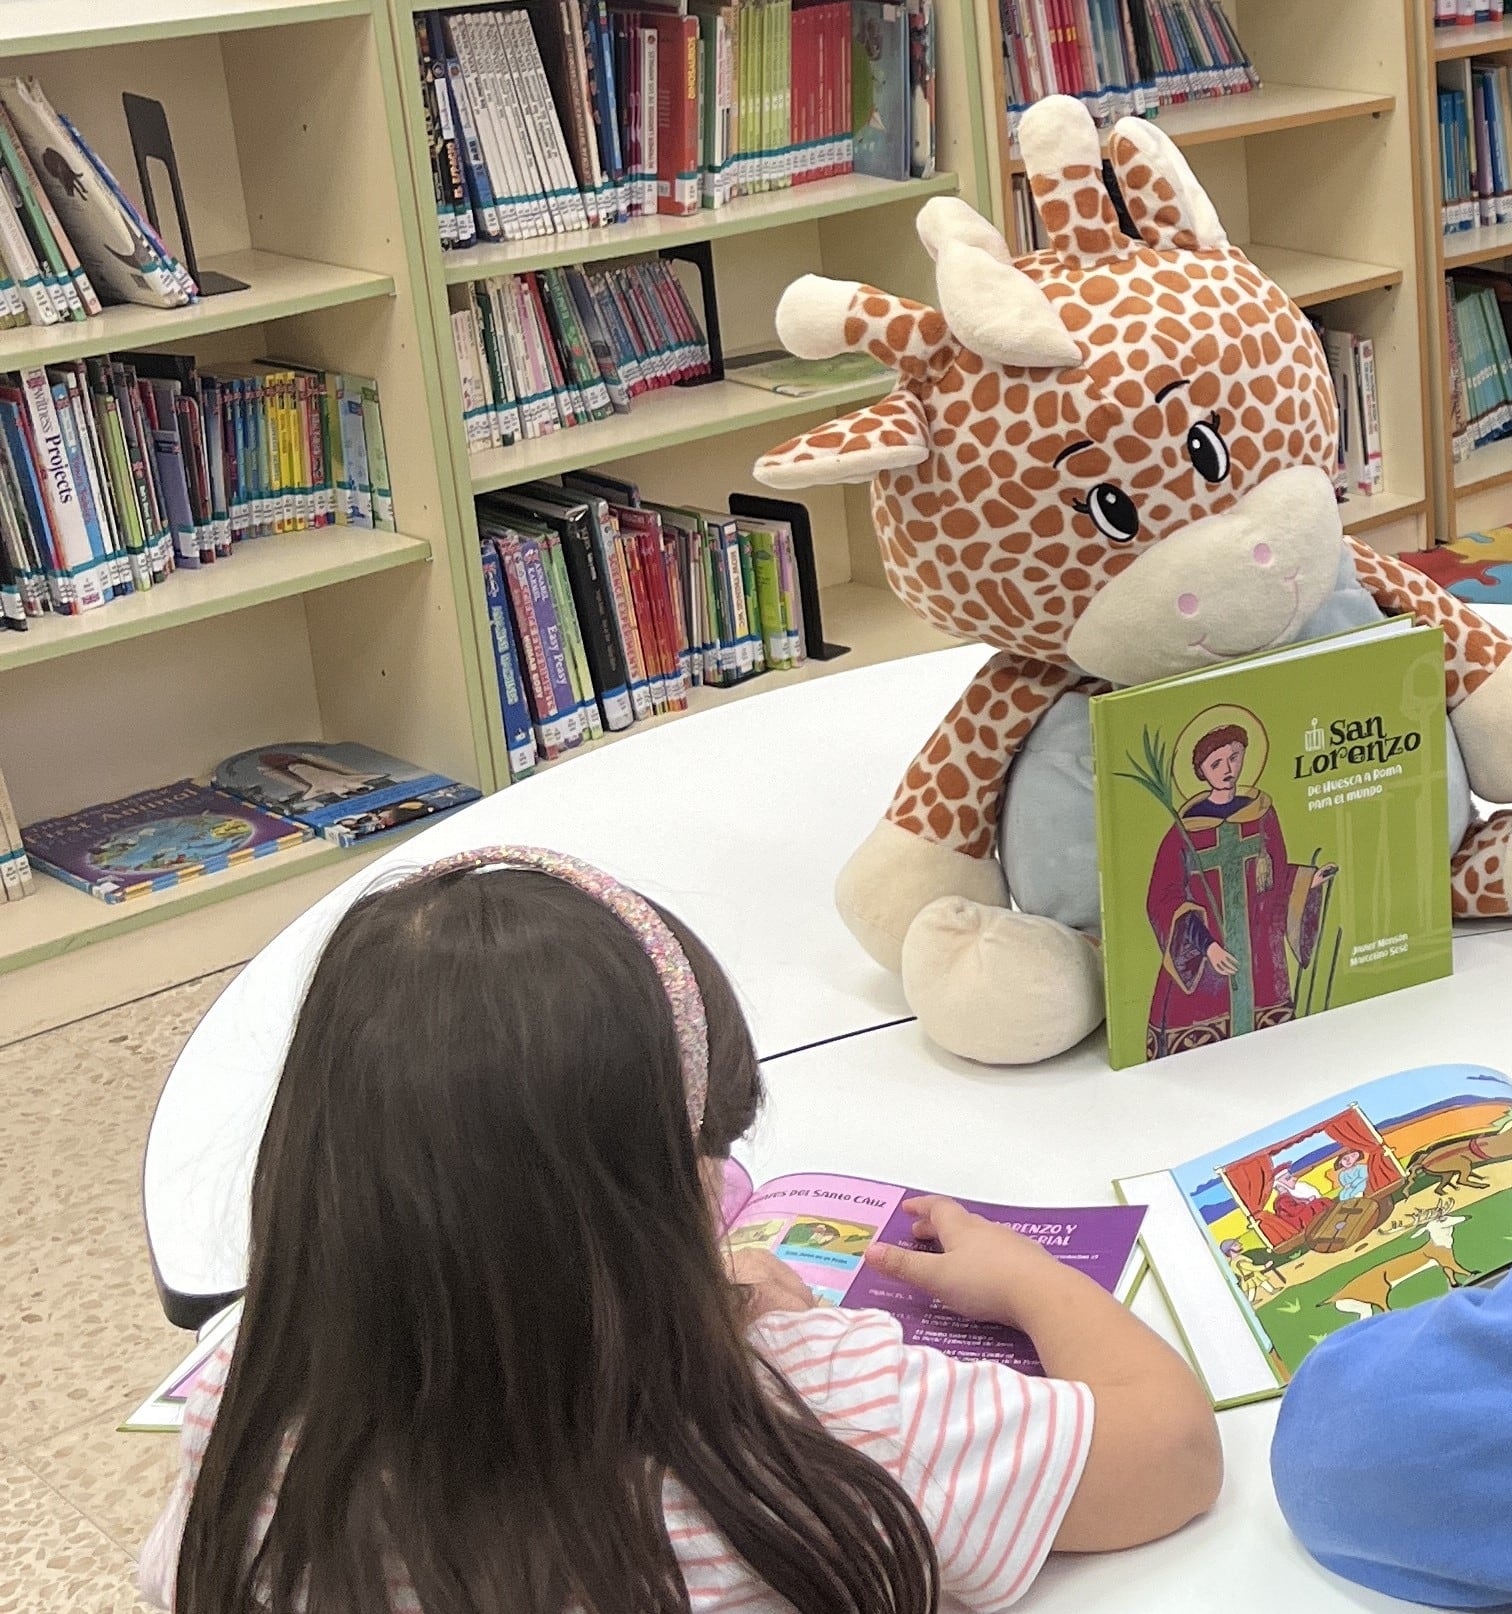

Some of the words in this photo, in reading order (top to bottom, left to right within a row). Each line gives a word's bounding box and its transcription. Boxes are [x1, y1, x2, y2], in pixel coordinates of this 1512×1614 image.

[28, 369, 53, 433] Ewitness
[45, 434, 73, 504] Projects
[608, 553, 624, 599] SCIENCE
[617, 601, 638, 679] EXPERIMENTS
[547, 624, 560, 654] Easy
[554, 653, 568, 686] Peasy
[1329, 715, 1388, 746] San
[1293, 731, 1421, 779] Lorenzo
[1029, 1234, 1071, 1246] RIAL
[1065, 1223, 1078, 1235] Y
